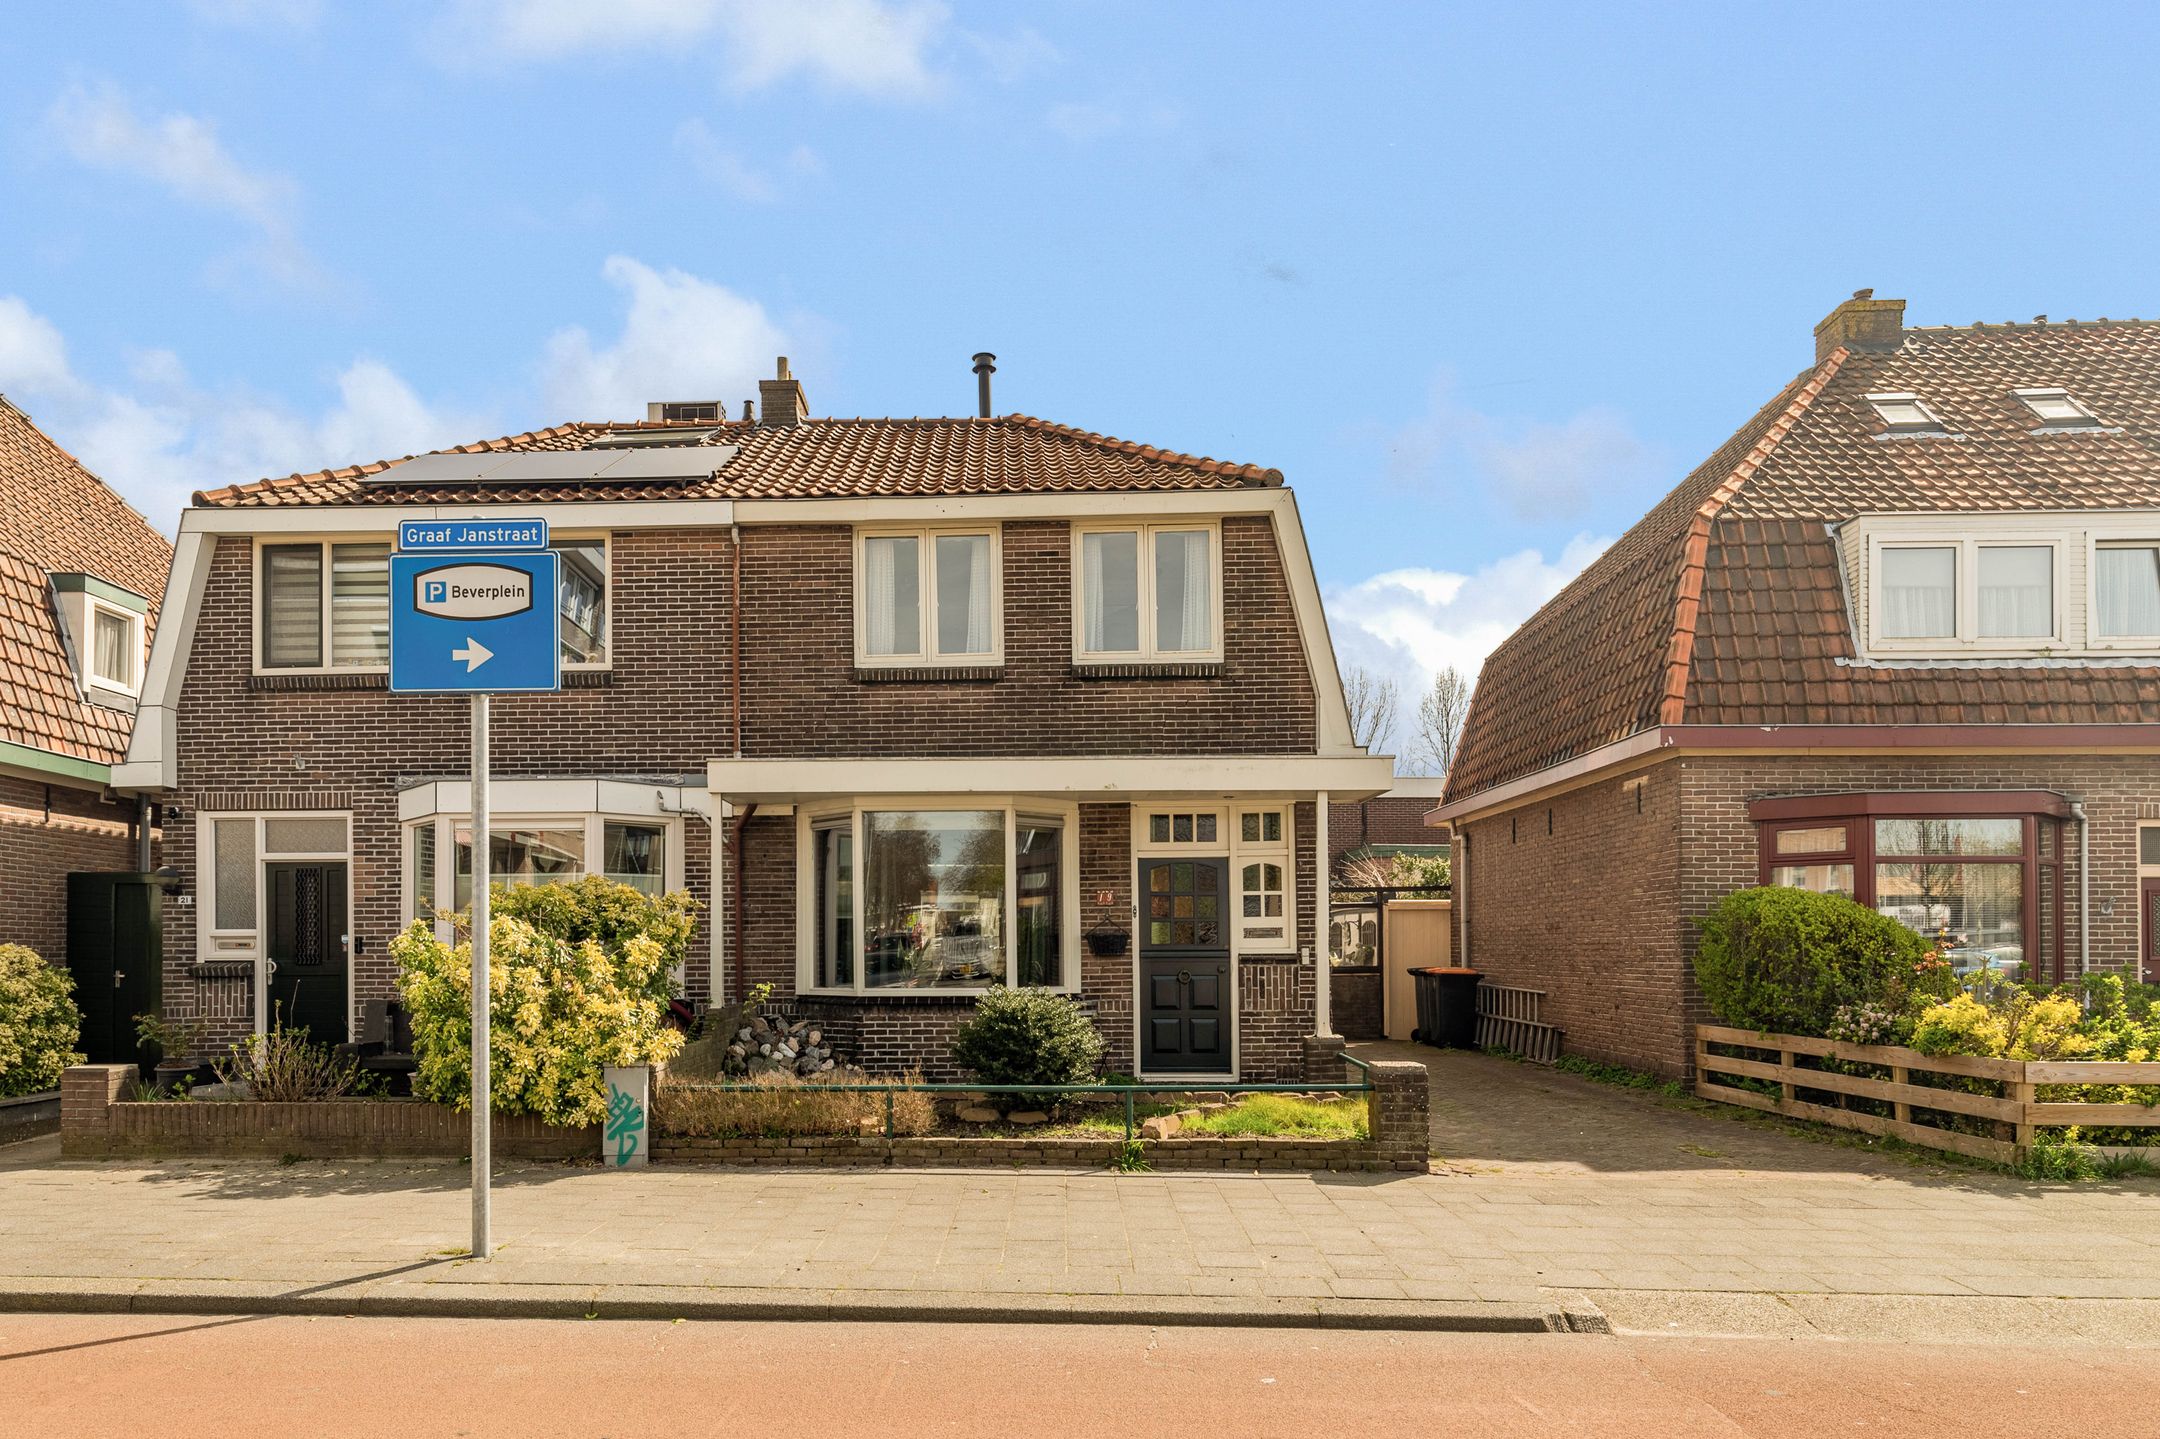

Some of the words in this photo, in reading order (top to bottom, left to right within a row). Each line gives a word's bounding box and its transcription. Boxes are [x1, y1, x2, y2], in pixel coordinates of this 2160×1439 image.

[407, 528, 451, 543] Graaf
[457, 528, 538, 542] Janstraat
[430, 583, 443, 602] P
[452, 585, 525, 600] Beverplein
[180, 896, 189, 904] 21
